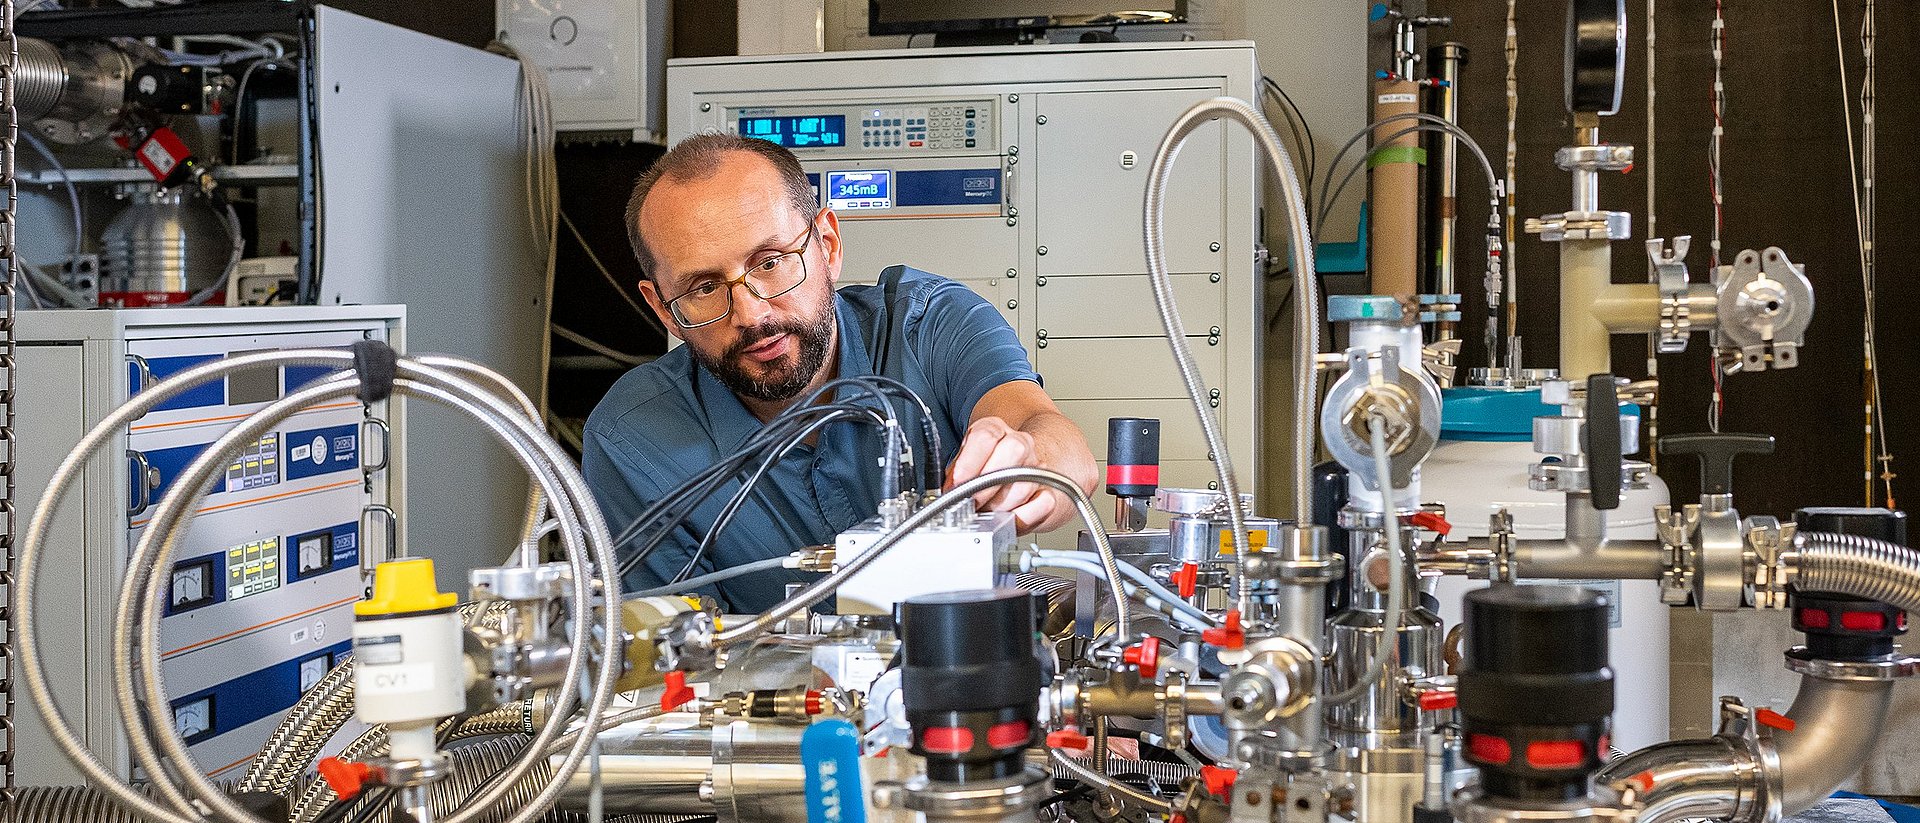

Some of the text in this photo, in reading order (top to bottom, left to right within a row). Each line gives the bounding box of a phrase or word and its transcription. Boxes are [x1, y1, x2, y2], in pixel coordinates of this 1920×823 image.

[839, 184, 879, 196] 345mB
[375, 672, 407, 688] CV1
[523, 698, 534, 733] RETURN
[818, 759, 842, 823] ALVE
